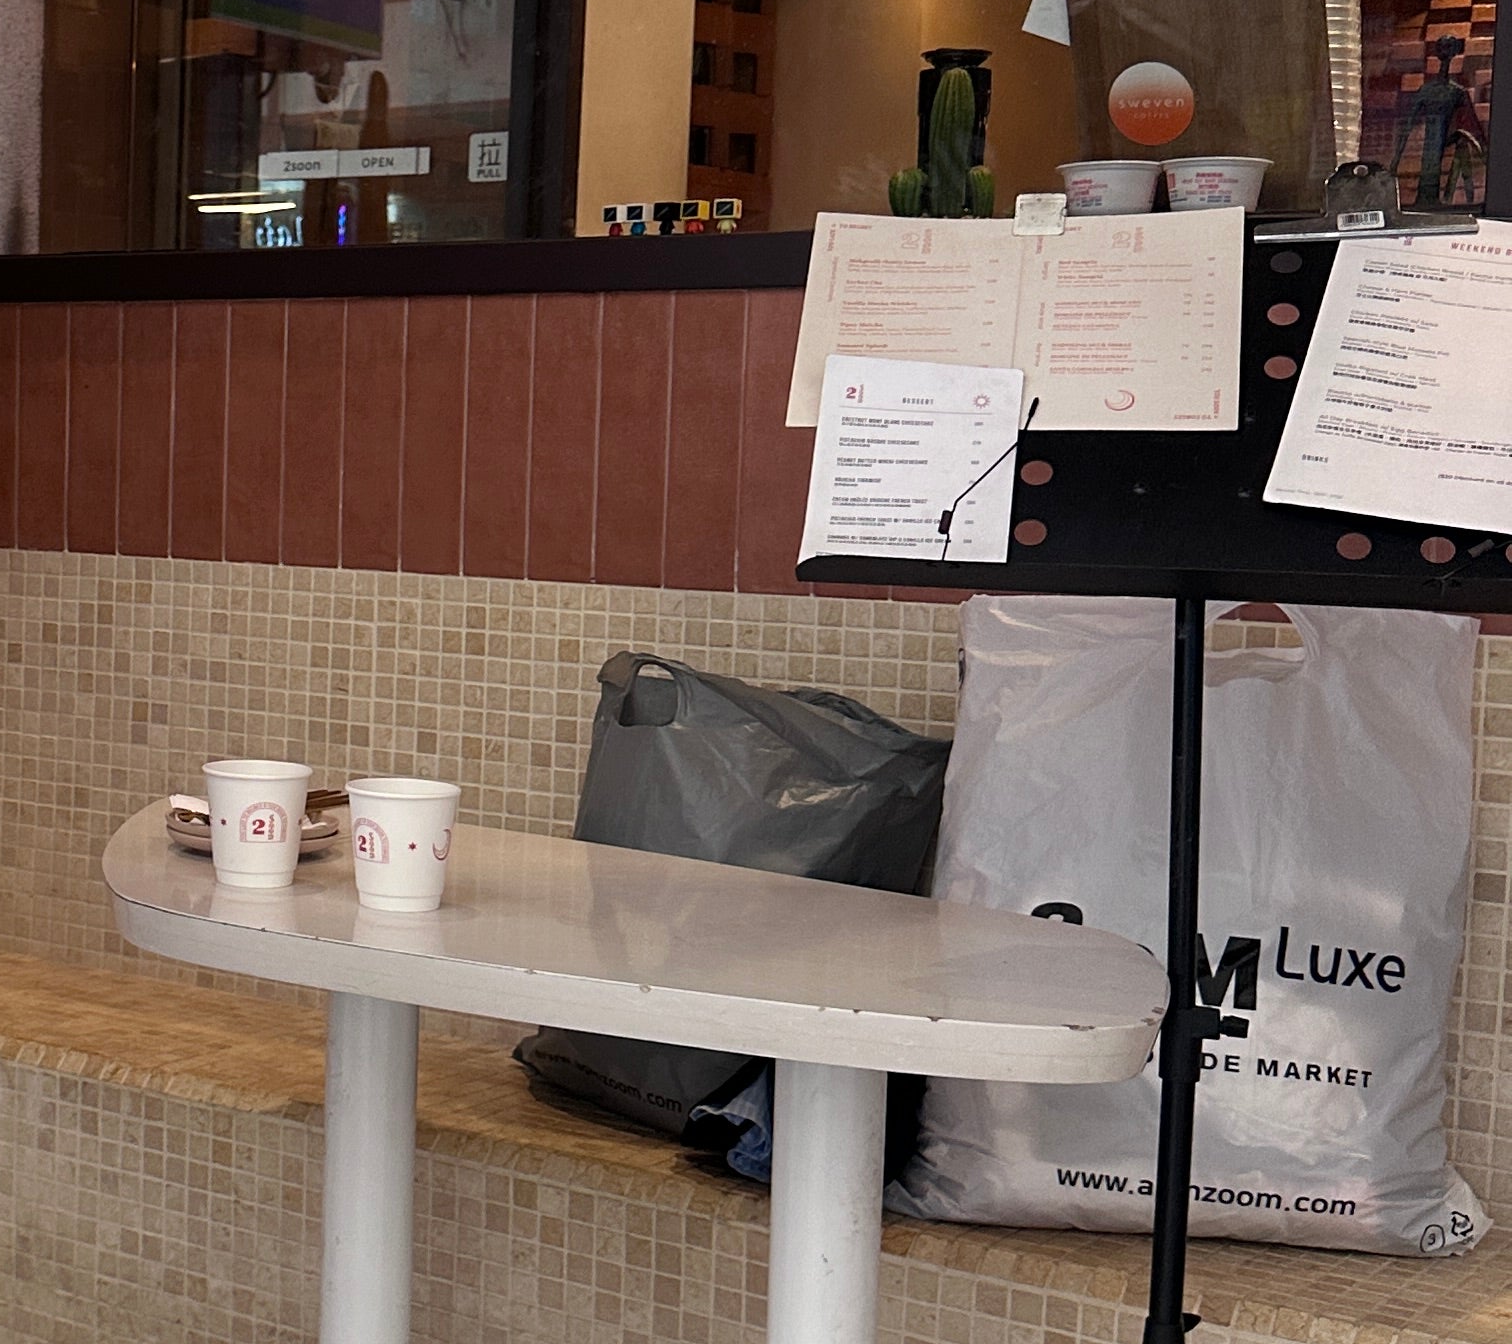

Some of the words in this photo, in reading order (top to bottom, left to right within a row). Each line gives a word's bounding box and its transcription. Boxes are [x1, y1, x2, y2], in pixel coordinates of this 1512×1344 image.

[1118, 97, 1185, 109] sweven
[478, 137, 502, 168] 拉
[283, 159, 321, 173] 2soon
[361, 156, 395, 170] OPEN
[476, 167, 501, 179] PULL
[1450, 242, 1501, 255] WEEKEND
[845, 386, 857, 399] 2
[252, 819, 266, 834] 2
[358, 835, 367, 852] 2
[1275, 926, 1407, 993] Luxe
[1256, 1057, 1373, 1089] MARKET
[1056, 1167, 1357, 1217] www.azoom.com
